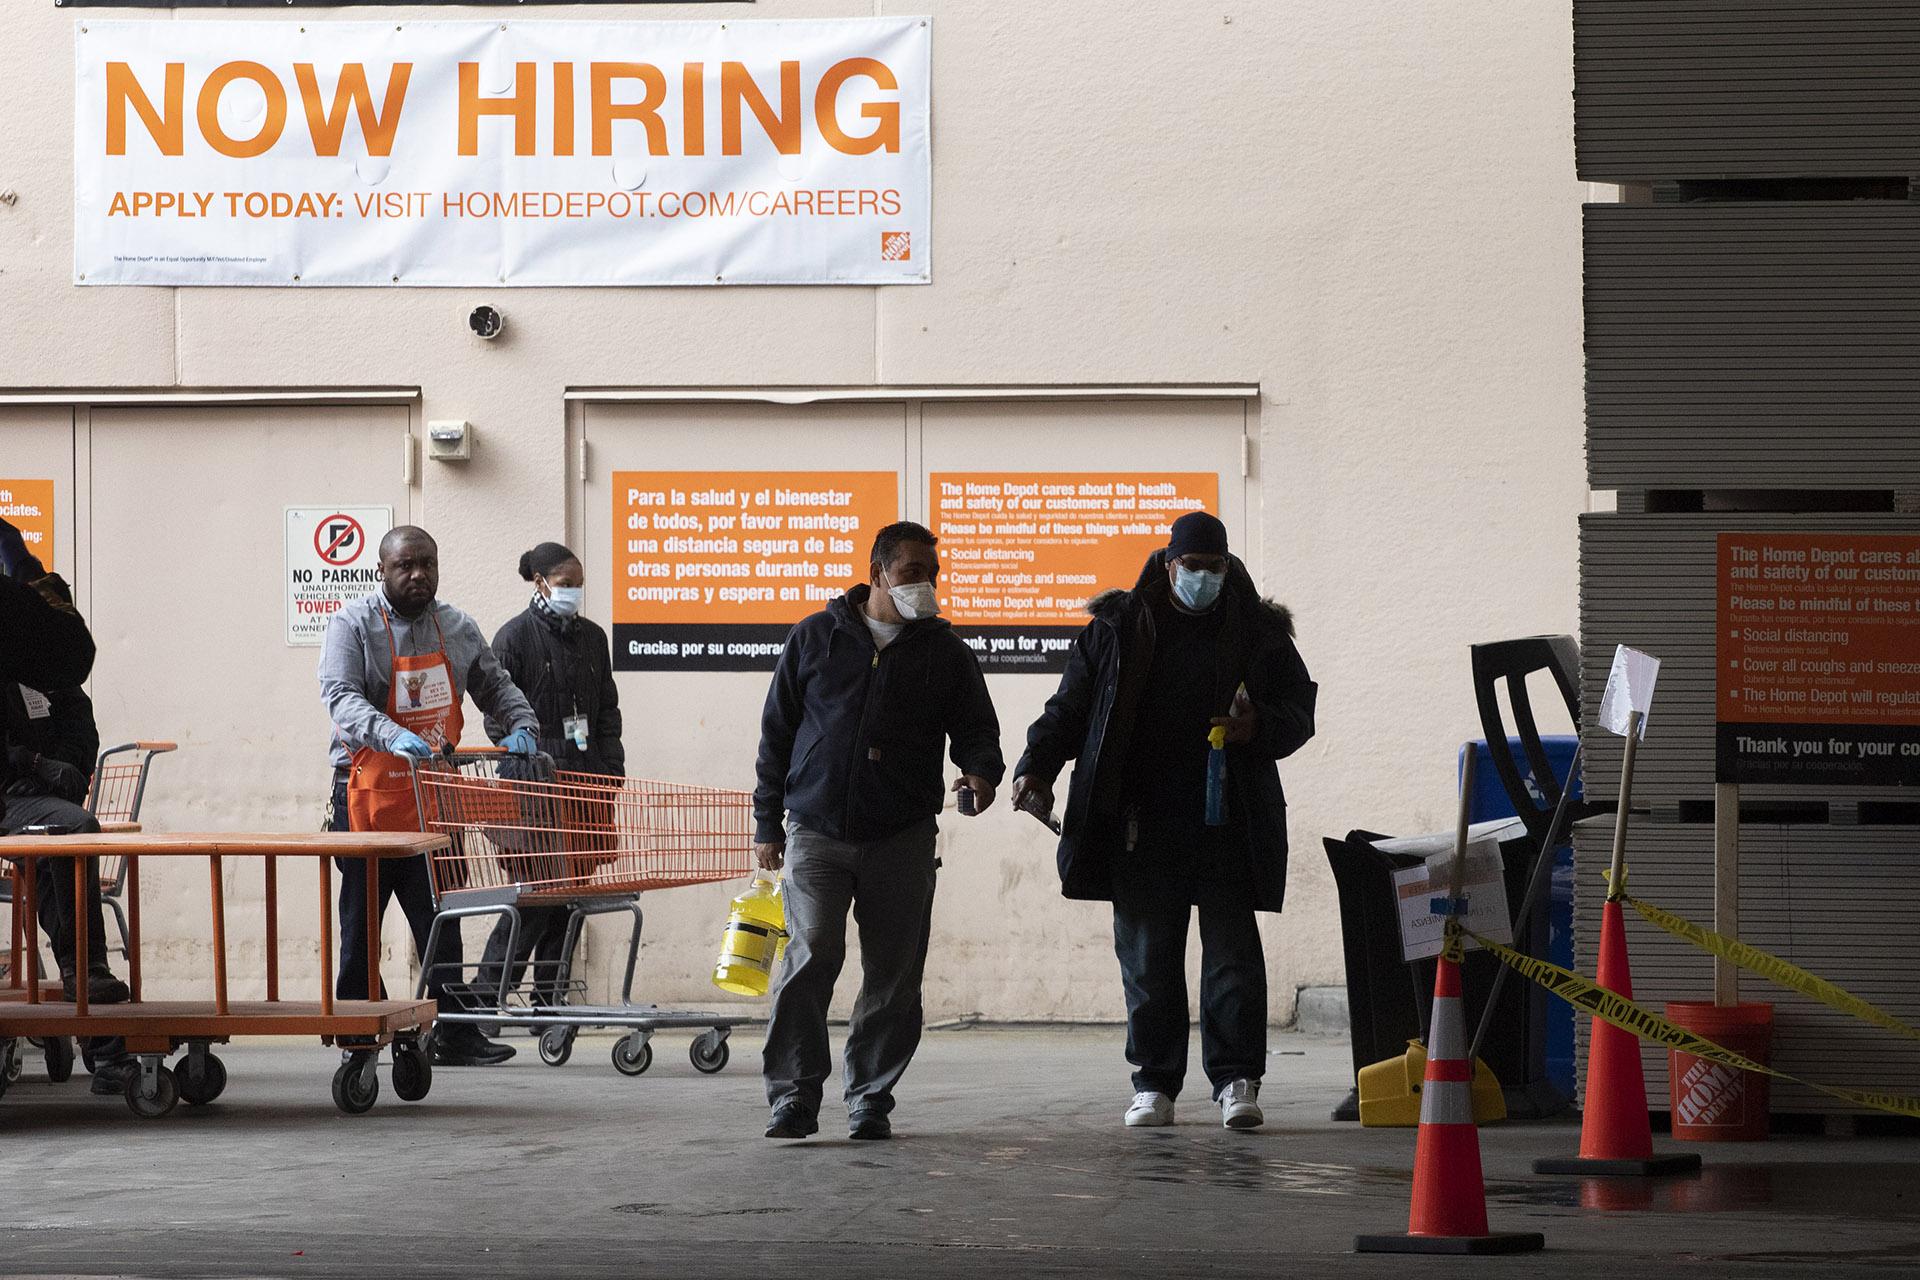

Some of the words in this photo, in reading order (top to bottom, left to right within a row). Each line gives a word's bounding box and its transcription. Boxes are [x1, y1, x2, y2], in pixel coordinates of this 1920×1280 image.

[106, 61, 413, 158] NOW
[458, 57, 900, 156] HIRING
[108, 192, 214, 218] APPLY
[224, 192, 342, 218] TODAY:
[354, 192, 432, 218] VISIT
[443, 190, 900, 218] HOMEDEPOT.COM/CAREERS
[628, 489, 665, 506] Para
[671, 489, 686, 506] la
[691, 489, 734, 506] salud
[740, 493, 750, 509] y
[756, 489, 770, 506] el
[776, 489, 852, 506] bienestar
[941, 483, 962, 496] The
[966, 483, 1000, 496] Home
[1004, 483, 1038, 498] Depot
[1042, 485, 1074, 496] cares
[1078, 483, 1112, 496] about
[1116, 483, 1135, 496] the
[1138, 483, 1176, 496] health
[941, 497, 962, 509] and
[966, 497, 1002, 512] safety
[1006, 497, 1019, 509] of
[1022, 499, 1042, 509] our
[1046, 498, 1109, 509] customers
[1113, 497, 1135, 509] and
[1139, 497, 1205, 509] associates.
[628, 513, 648, 530] de
[653, 513, 702, 532] todos,
[708, 516, 736, 532] por
[740, 513, 784, 530] favor
[788, 513, 859, 533] mantega
[941, 523, 976, 534] Please
[979, 523, 992, 534] be
[996, 523, 1036, 534] mindful
[1040, 523, 1050, 534] of
[1054, 523, 1082, 534] these
[1086, 523, 1118, 536] things
[1122, 523, 1152, 534] while
[628, 540, 658, 553] una
[663, 536, 738, 553] distancia
[743, 540, 798, 556] segura
[804, 536, 824, 553] de
[830, 536, 853, 553] las
[950, 548, 980, 560] Social
[984, 548, 1034, 562] distancing
[1730, 546, 1758, 562] The
[1763, 546, 1806, 562] Home
[1811, 546, 1854, 565] Depot
[1859, 551, 1900, 562] cares
[293, 570, 312, 582] NO
[628, 561, 670, 577] otras
[676, 564, 750, 580] personas
[756, 561, 818, 577] durante
[824, 564, 852, 577] sus
[950, 572, 979, 584] Cover
[982, 572, 993, 584] all
[996, 572, 1032, 586] coughs
[1035, 572, 1054, 584] and
[1056, 574, 1096, 584] sneezes
[1730, 565, 1758, 579] and
[1764, 565, 1810, 582] safety
[1814, 565, 1830, 579] of
[1834, 568, 1860, 579] our
[302, 584, 375, 592] UNAUTHORIZED
[628, 587, 699, 604] compras
[704, 587, 714, 604] y
[719, 587, 774, 604] espera
[780, 587, 800, 600] en
[951, 596, 969, 608] The
[972, 596, 1000, 608] Home
[1004, 596, 1034, 609] Depot
[1036, 596, 1052, 608] will
[1730, 596, 1774, 610] Please
[1779, 597, 1795, 610] be
[1800, 597, 1850, 610] mindful
[1856, 597, 1870, 610] of
[1872, 598, 1910, 612] these
[990, 638, 1015, 652] you
[1018, 636, 1038, 650] for
[1041, 638, 1072, 652] your
[1744, 628, 1780, 642] Social
[1785, 628, 1848, 645] distancing
[628, 640, 678, 655] Gracias
[682, 643, 704, 657] por
[708, 643, 724, 655] su
[1000, 655, 1047, 664] cooperación.
[1743, 658, 1776, 672] Cover
[1782, 658, 1796, 672] all
[1800, 659, 1846, 675] coughs
[1850, 658, 1873, 672] and
[1743, 689, 1766, 702] The
[1770, 689, 1806, 702] Home
[1811, 689, 1846, 704] Depot
[1851, 690, 1872, 702] will
[1736, 737, 1788, 752] Thank
[1793, 740, 1823, 757] you
[1828, 739, 1852, 754] for
[1858, 742, 1895, 758] your
[1680, 1058, 1709, 1088] THE
